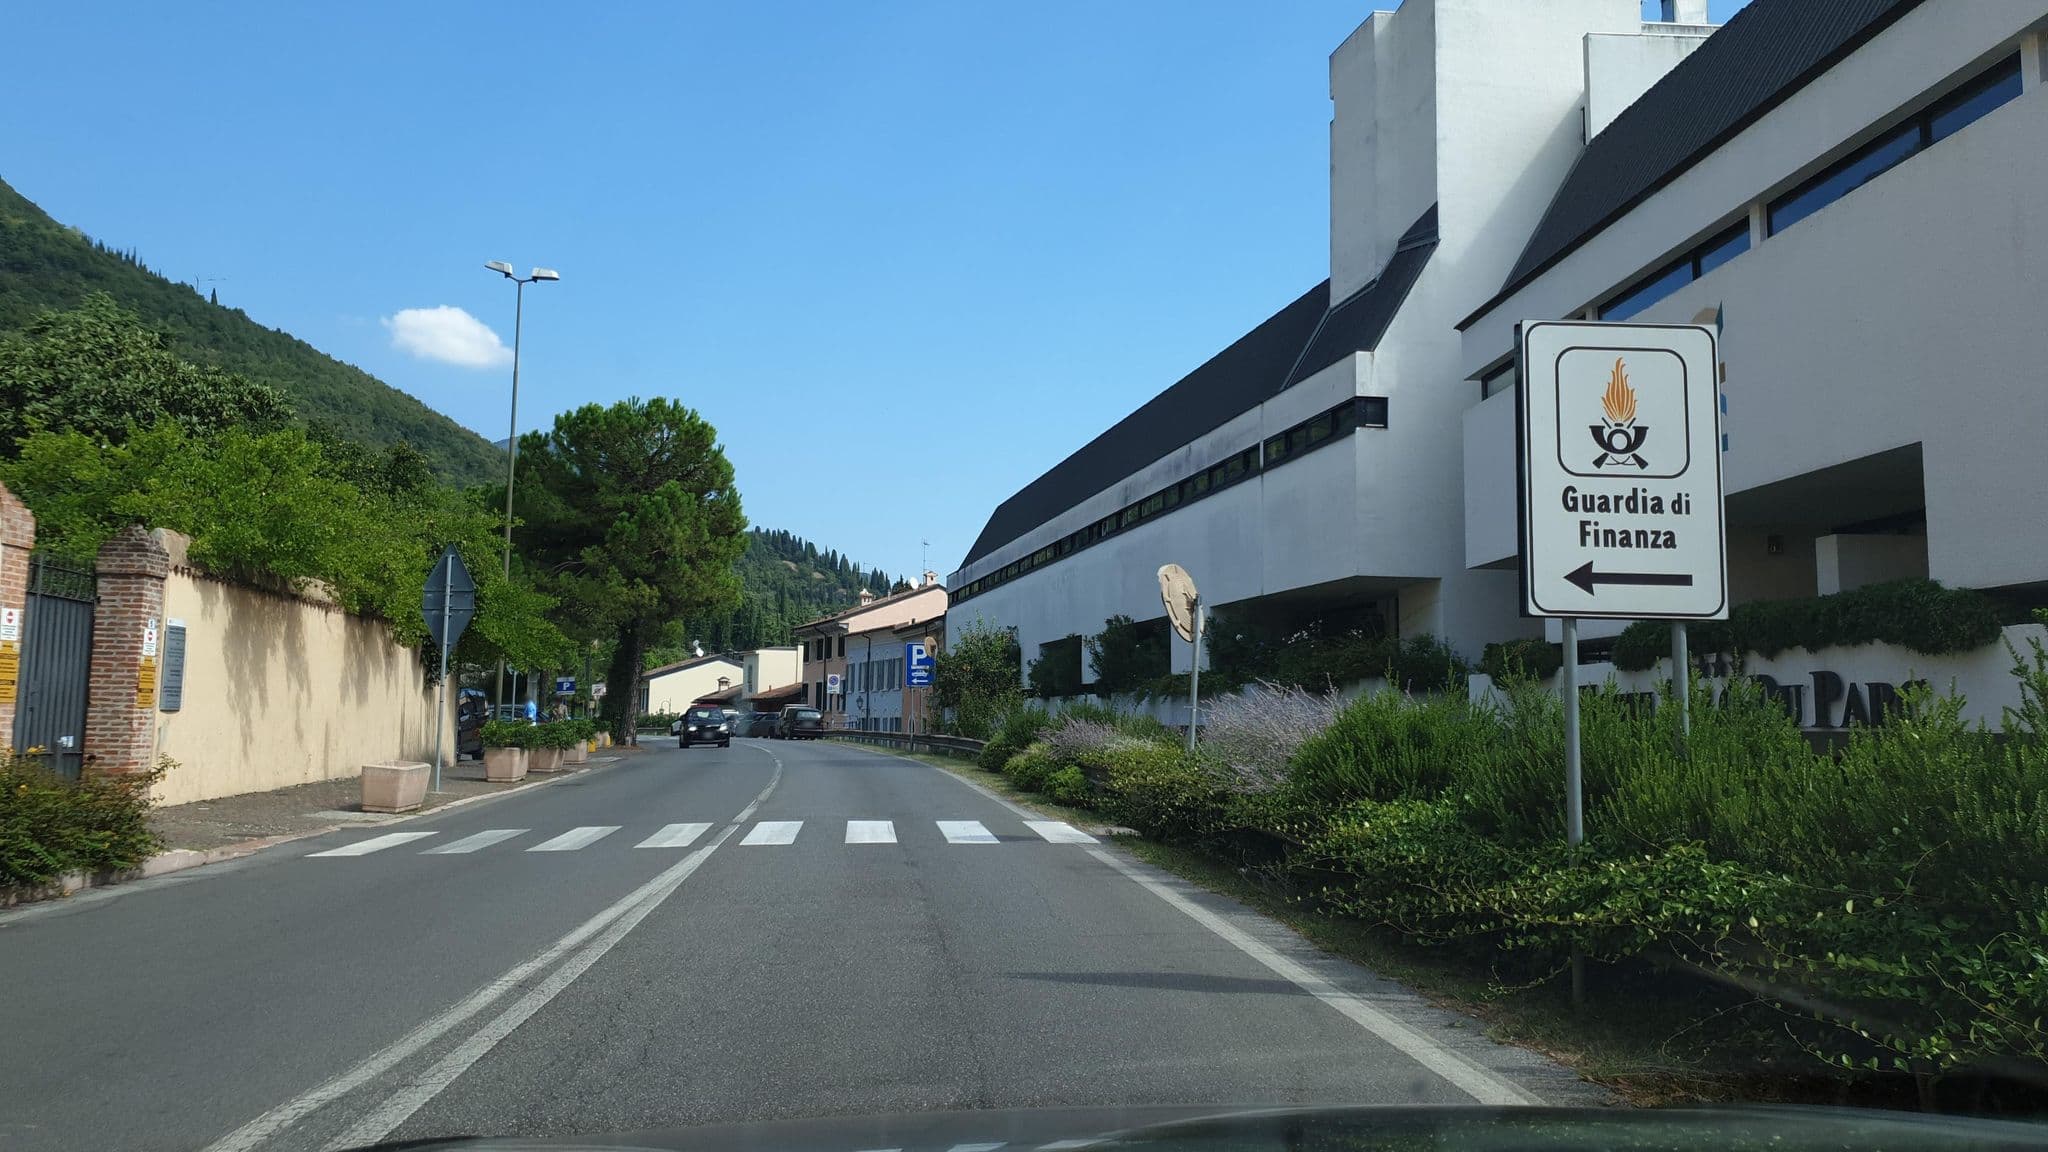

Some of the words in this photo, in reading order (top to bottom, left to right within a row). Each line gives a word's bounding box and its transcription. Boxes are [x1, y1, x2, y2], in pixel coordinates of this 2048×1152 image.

[1561, 485, 1665, 515] Guardia
[1671, 493, 1691, 515] di
[1579, 520, 1678, 549] Finanza
[912, 645, 928, 665] P
